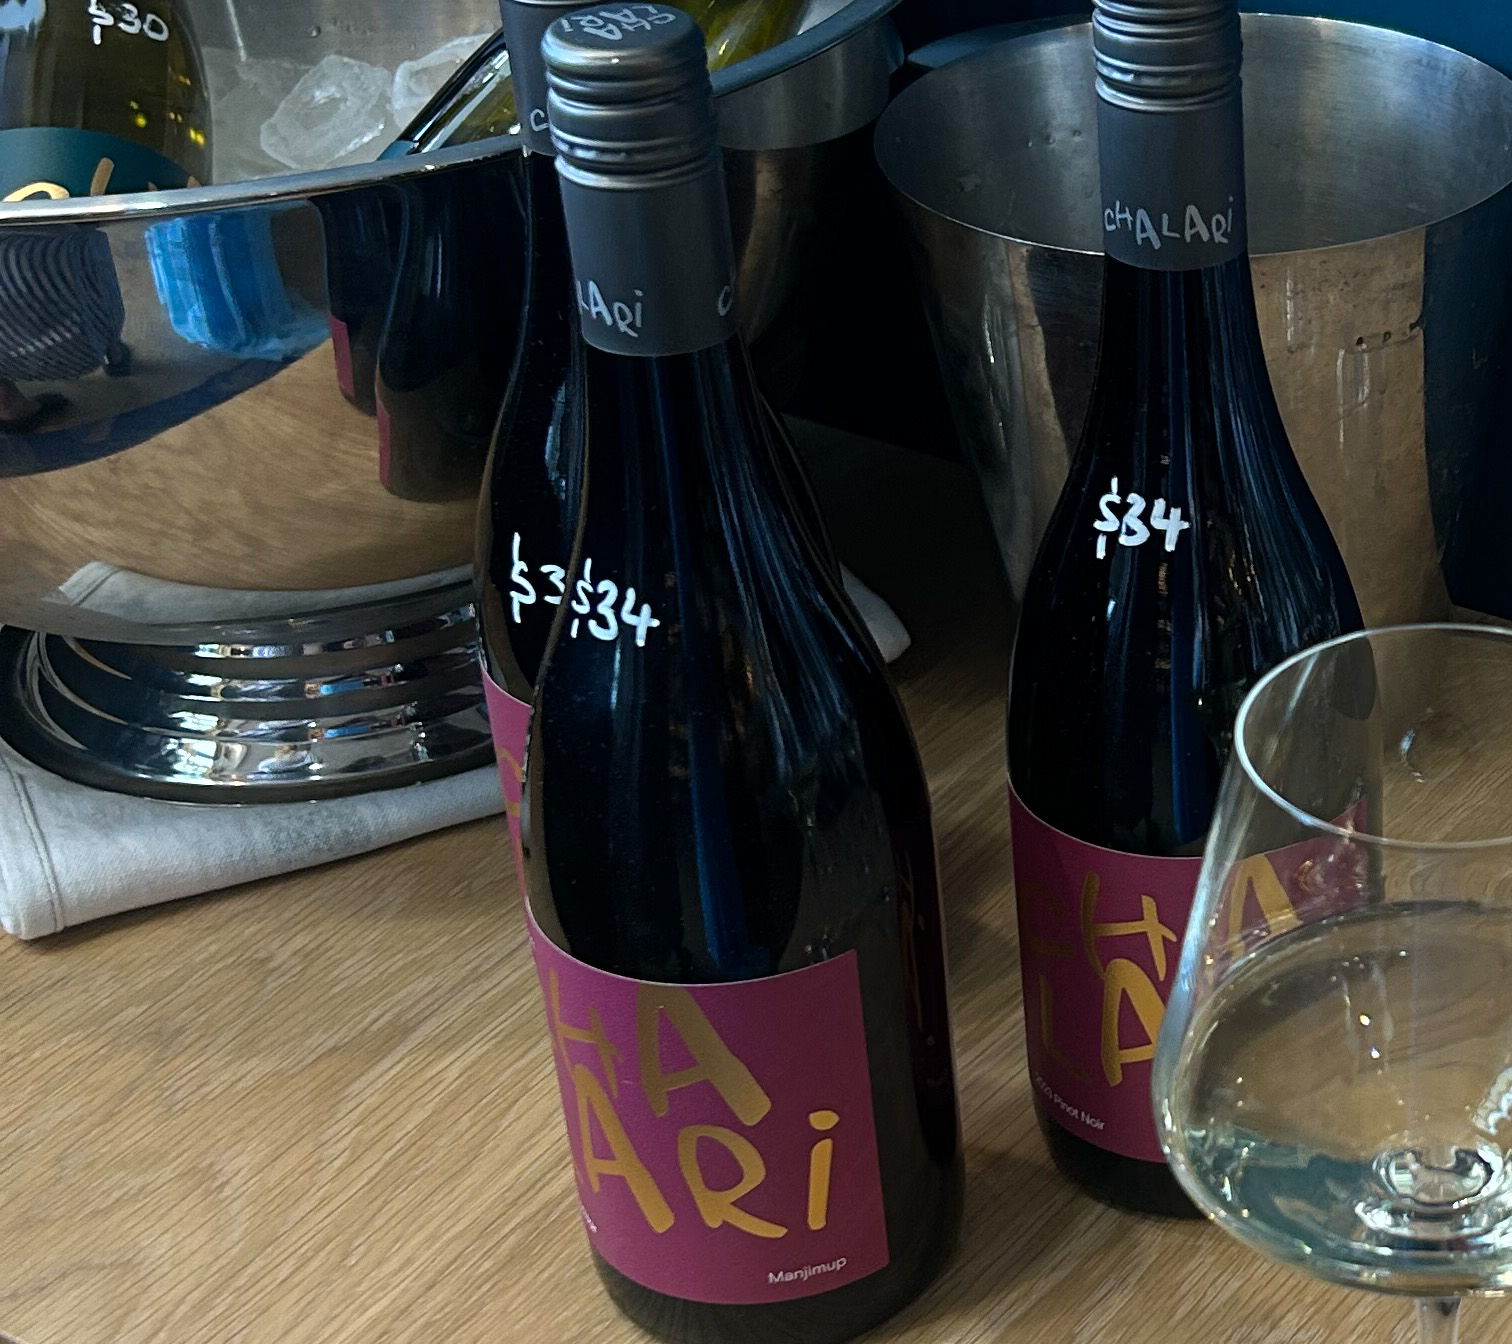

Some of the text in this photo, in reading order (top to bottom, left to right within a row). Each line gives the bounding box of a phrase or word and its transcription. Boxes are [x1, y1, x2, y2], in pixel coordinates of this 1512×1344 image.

[1093, 475, 1191, 560] $34
[570, 557, 661, 648] $34
[574, 1063, 841, 1239] ARi
[767, 1256, 848, 1285] Manjimup
